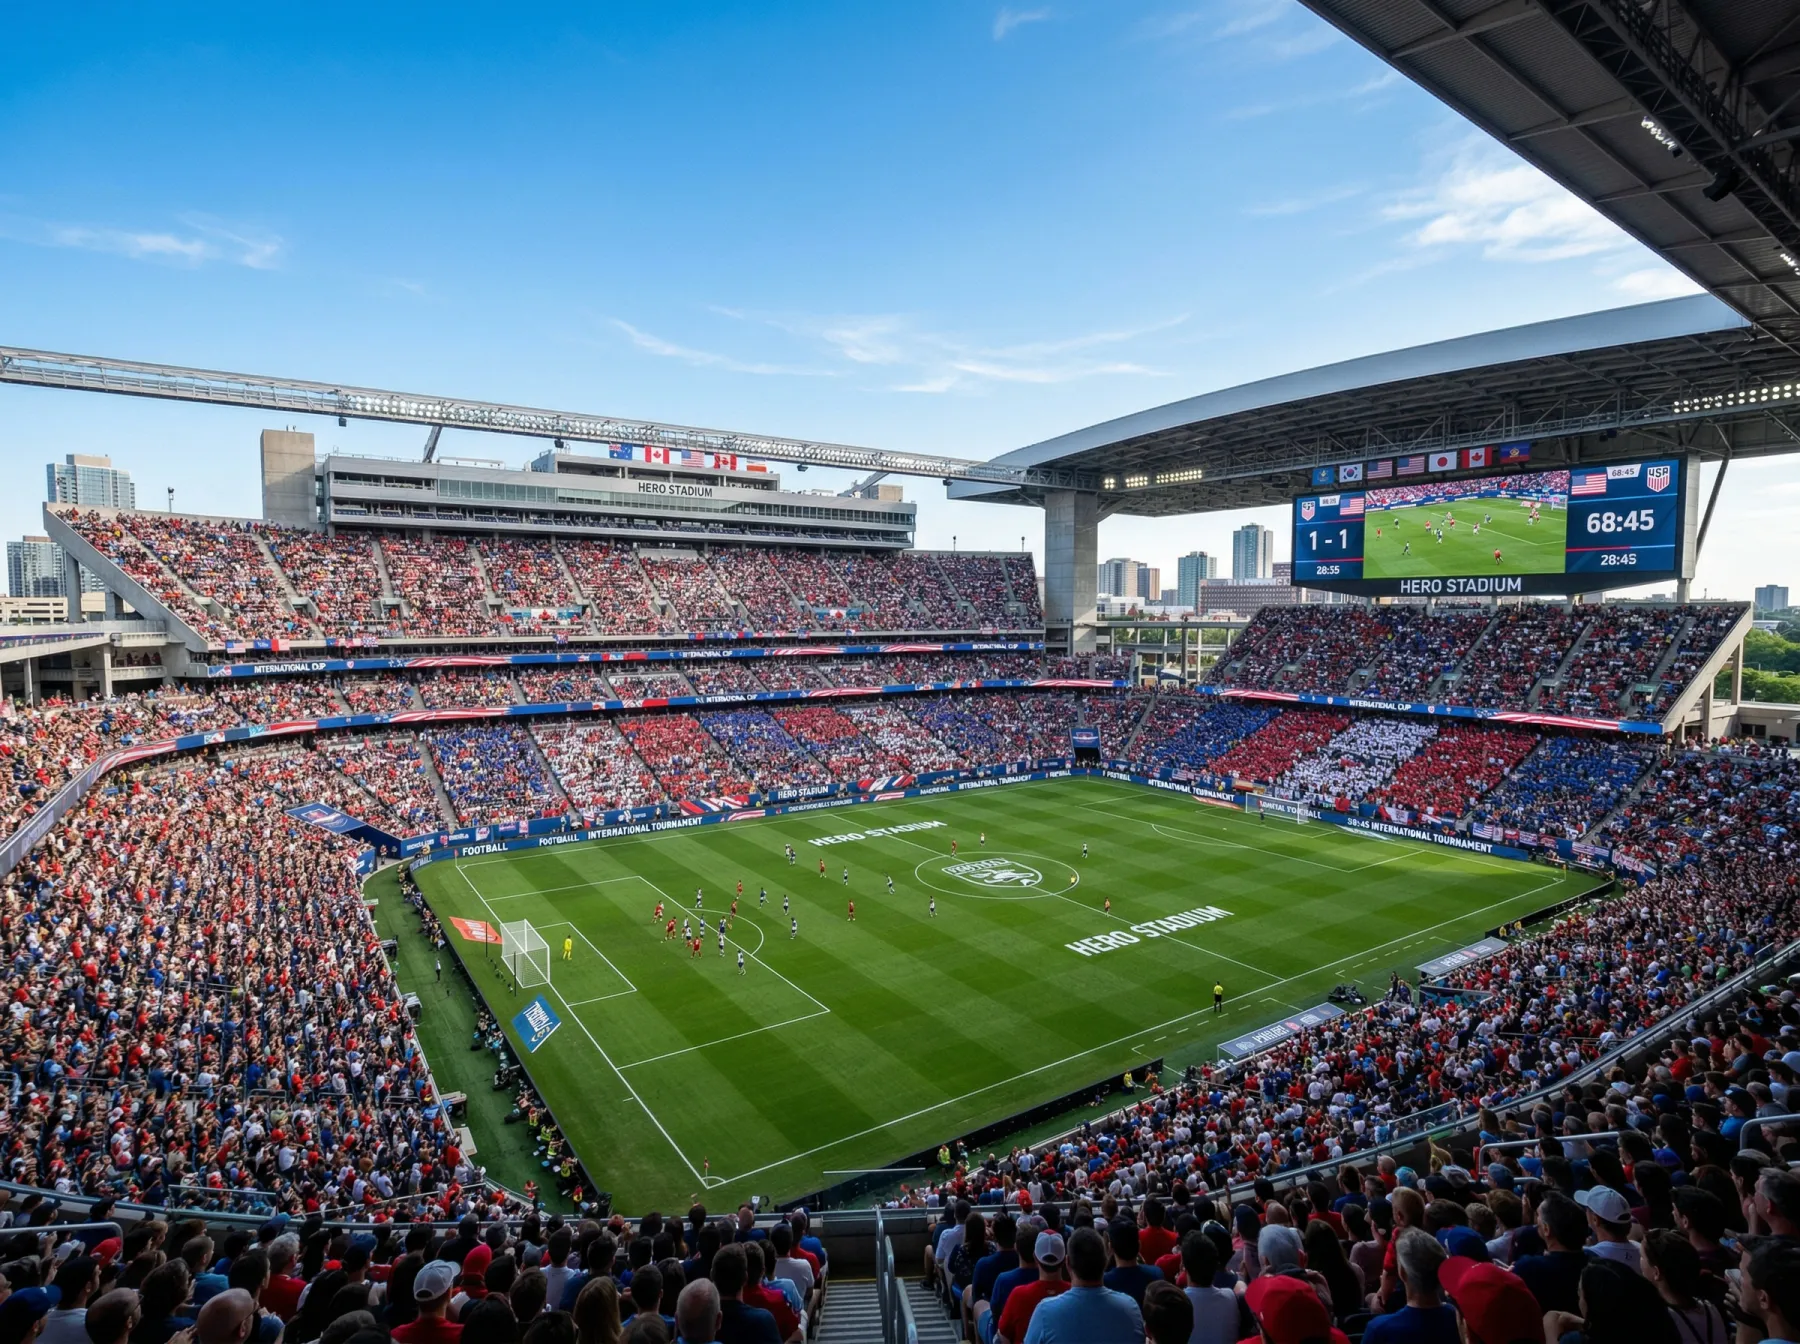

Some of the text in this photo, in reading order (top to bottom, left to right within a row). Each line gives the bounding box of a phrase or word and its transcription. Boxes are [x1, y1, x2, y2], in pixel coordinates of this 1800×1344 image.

[1611, 468, 1635, 477] 68:45
[1648, 467, 1669, 478] USA
[638, 482, 713, 498] HERO STADIUM
[1586, 509, 1655, 534] 68:45
[1309, 530, 1318, 551] 1
[1339, 528, 1347, 549] 1
[1600, 553, 1637, 566] 28:45
[1316, 565, 1340, 575] 28:55
[1400, 577, 1522, 594] HERO STADIUM
[808, 819, 948, 847] HERO STADIUM
[462, 842, 508, 856] FOOTBALL
[1433, 833, 1493, 853] TOURNAMENT
[1064, 905, 1235, 957] HERO STADIUM
